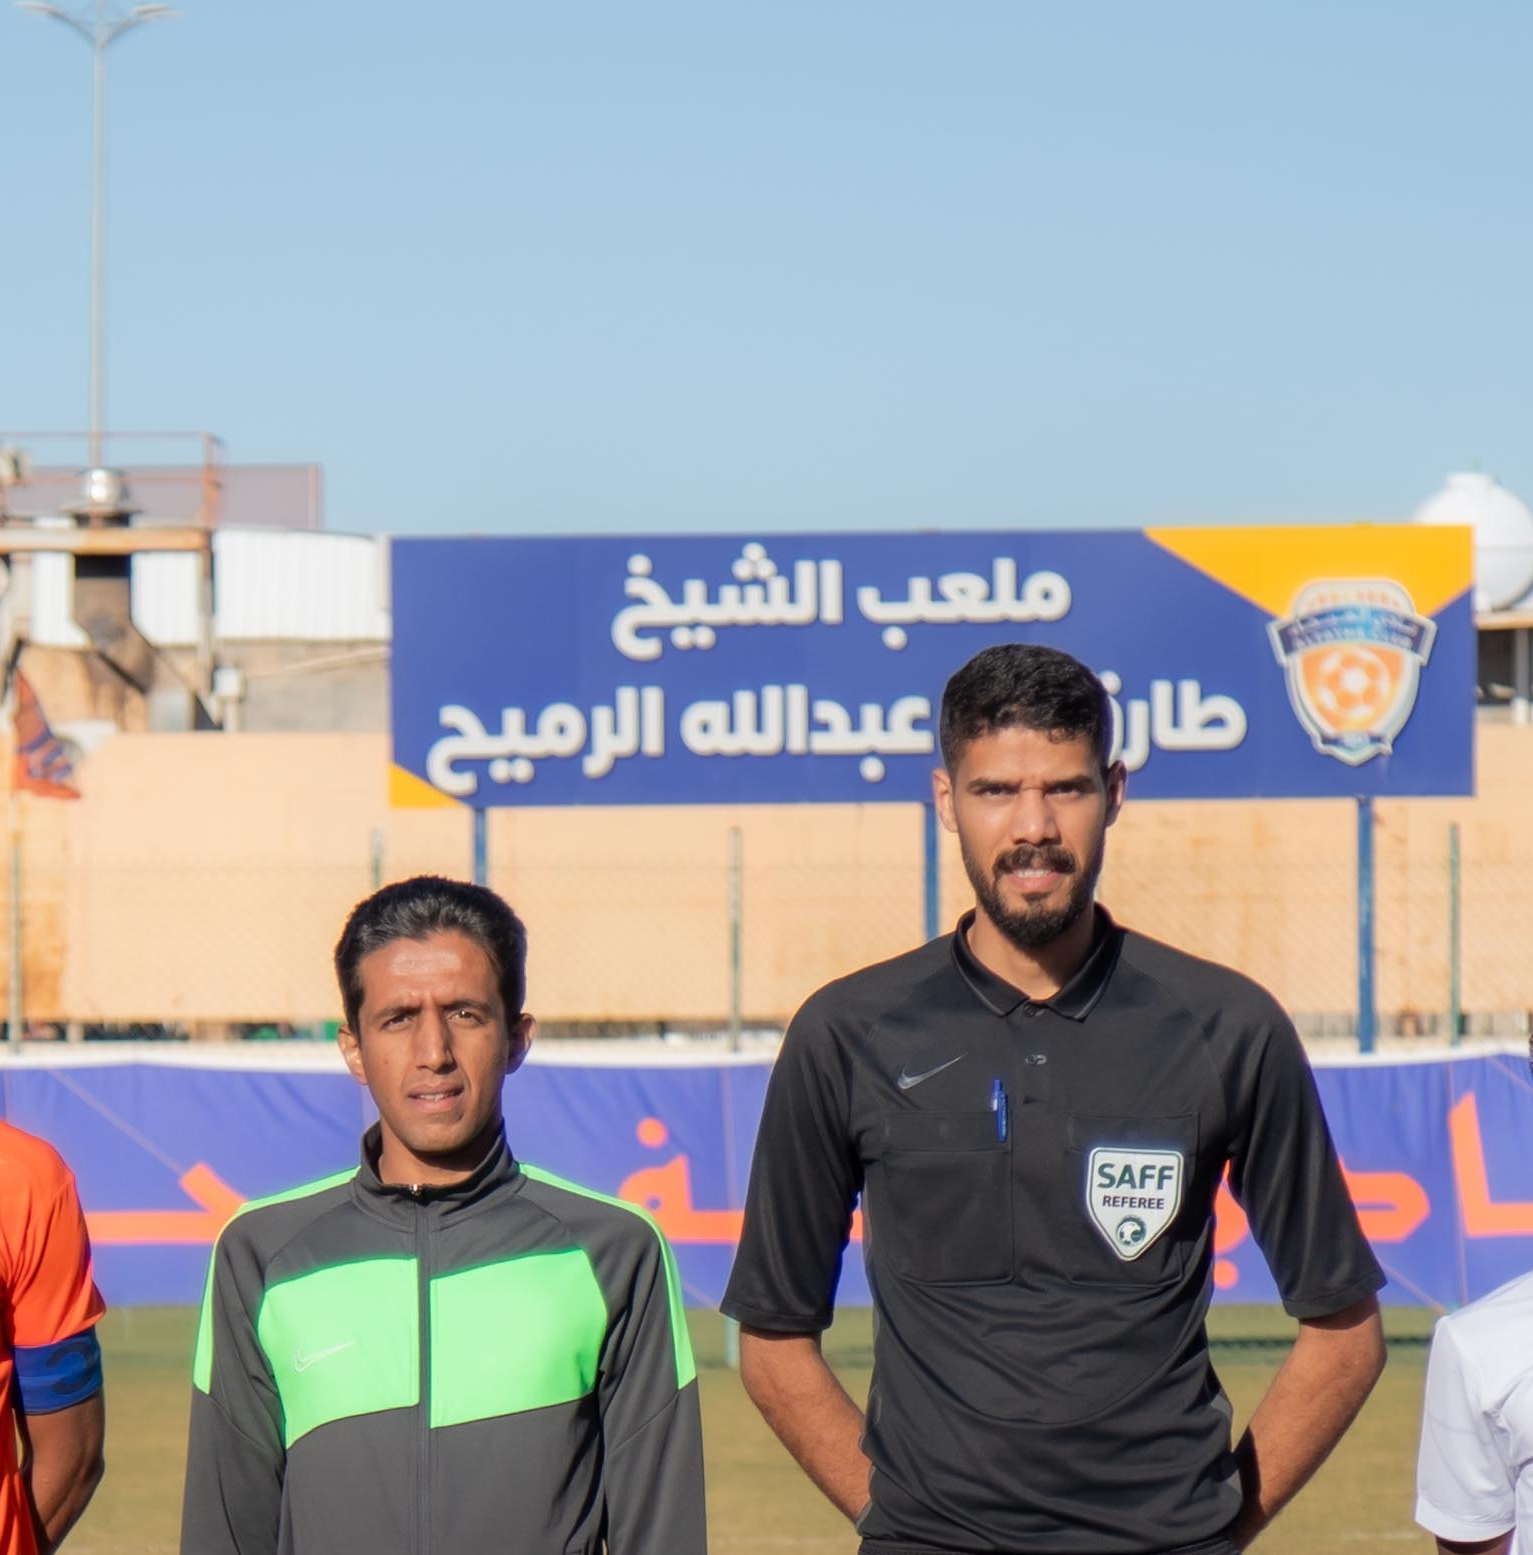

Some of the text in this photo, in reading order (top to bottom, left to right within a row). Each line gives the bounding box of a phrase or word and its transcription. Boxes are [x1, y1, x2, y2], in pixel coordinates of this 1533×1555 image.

[611, 542, 1073, 661] ملعب الشيخ
[425, 685, 666, 797] الرميح
[679, 683, 935, 783] عبدالله
[1097, 1162, 1175, 1190] SAFF
[1102, 1195, 1166, 1210] REFEREE
